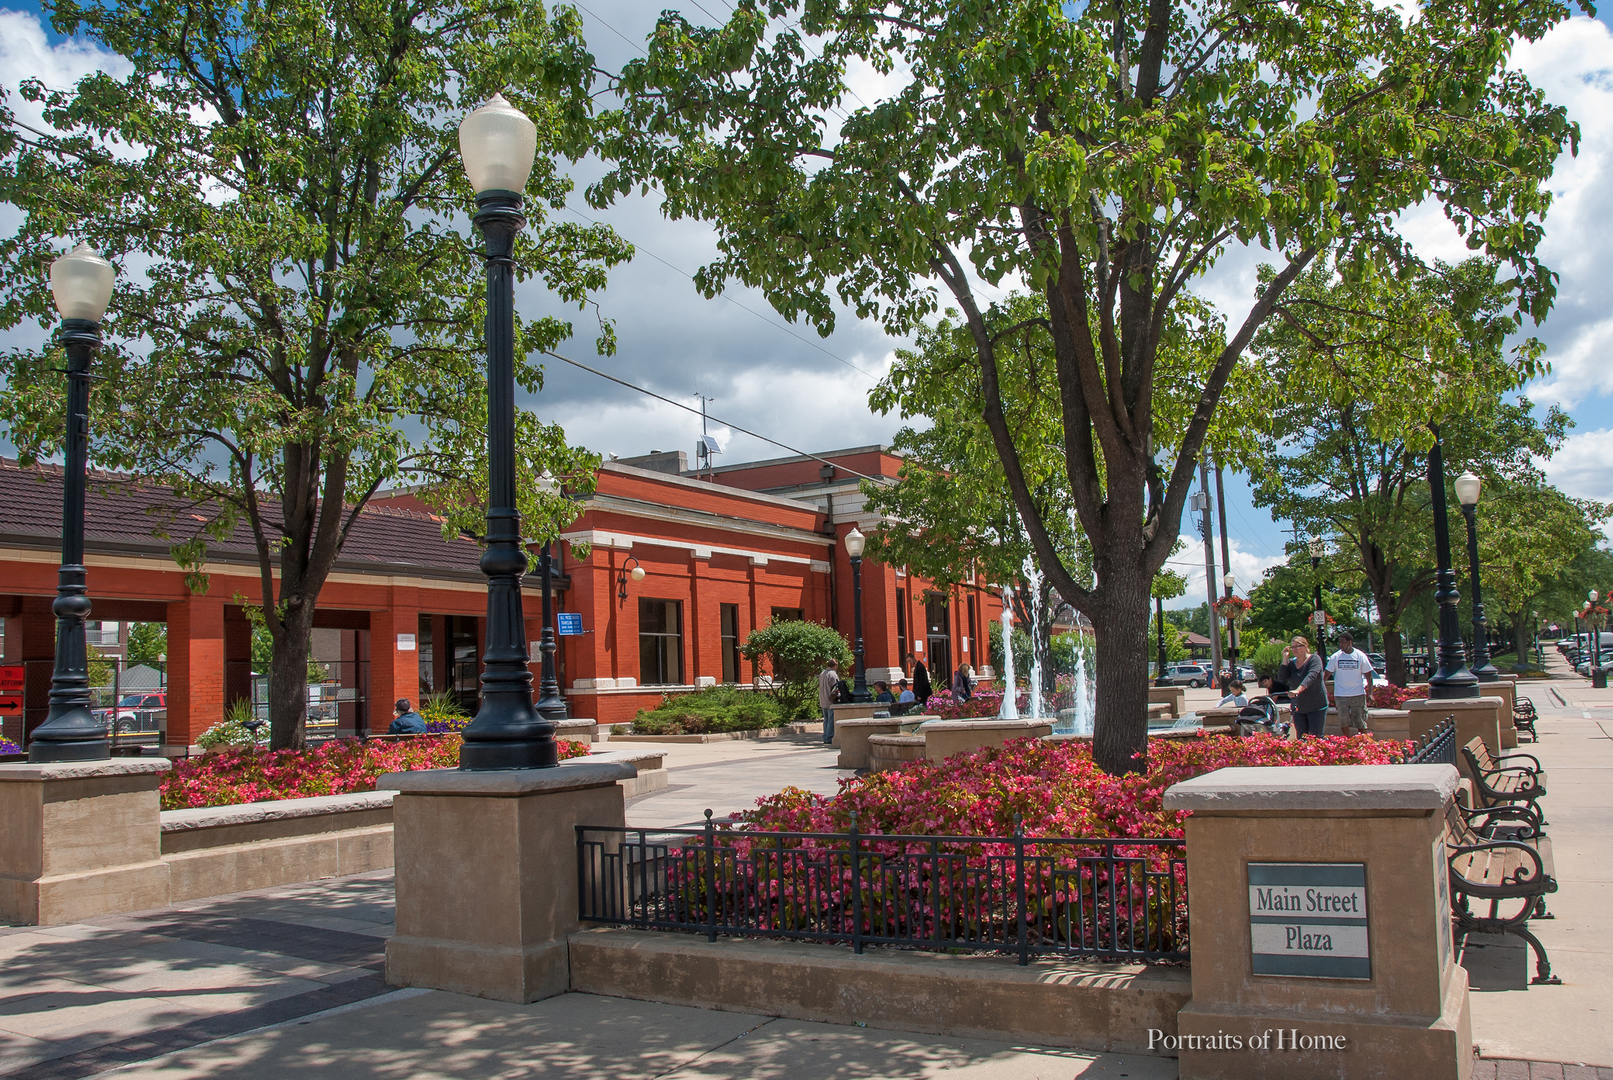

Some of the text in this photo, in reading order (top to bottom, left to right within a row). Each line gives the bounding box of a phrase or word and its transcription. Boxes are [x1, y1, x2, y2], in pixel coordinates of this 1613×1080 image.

[1256, 887, 1359, 913] Main Street
[1285, 925, 1333, 951] Plaza
